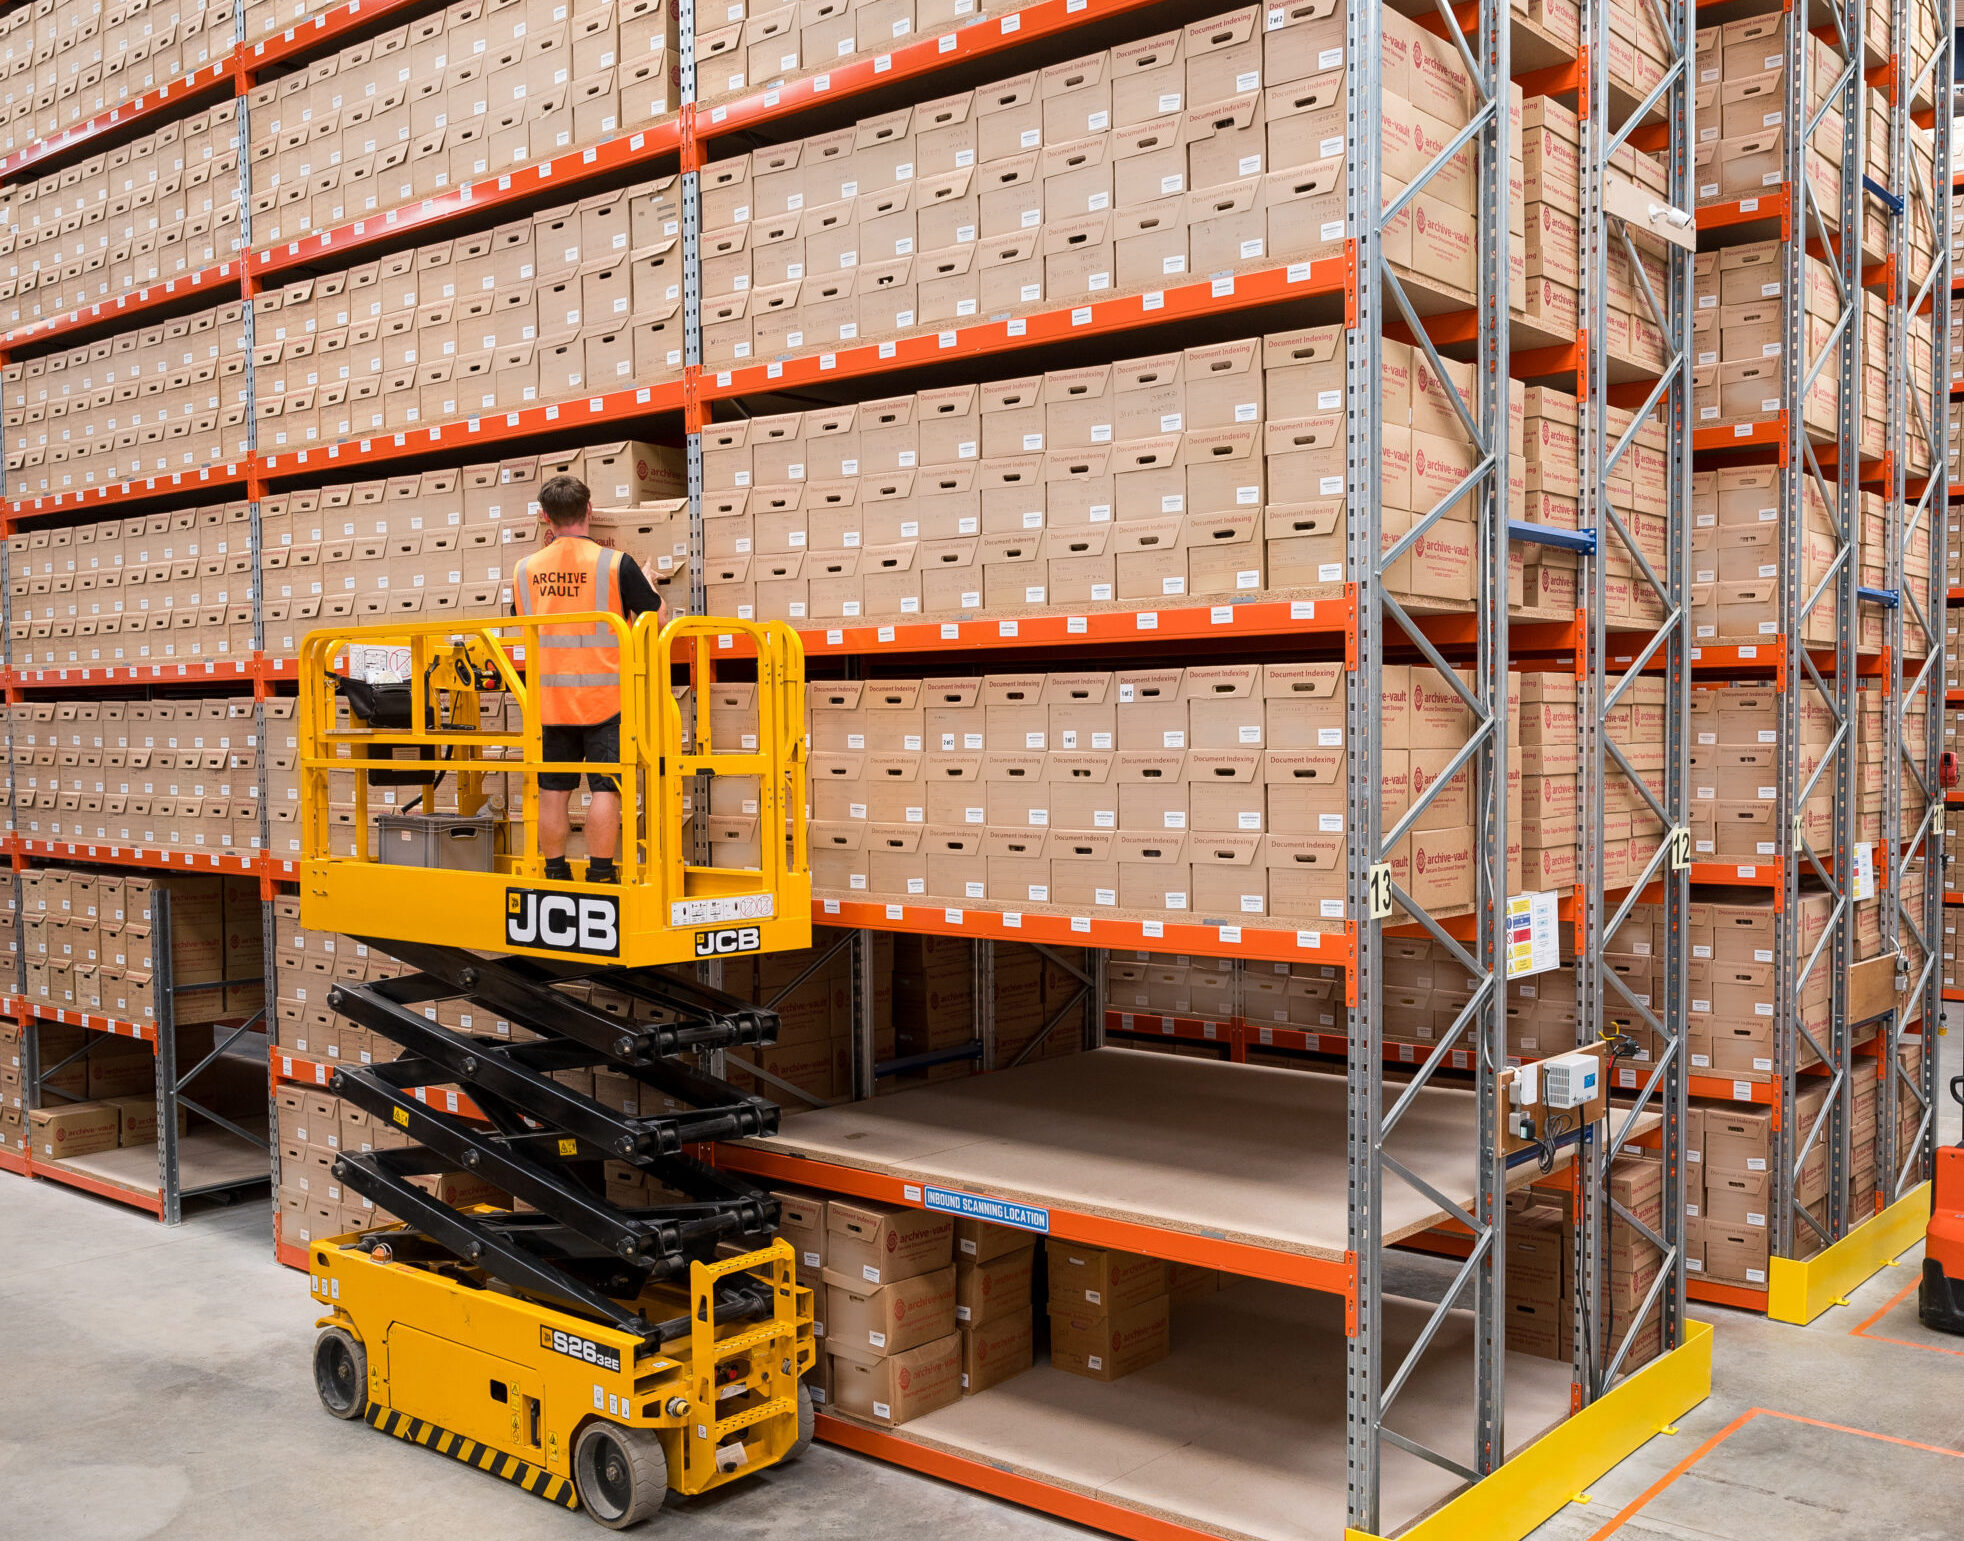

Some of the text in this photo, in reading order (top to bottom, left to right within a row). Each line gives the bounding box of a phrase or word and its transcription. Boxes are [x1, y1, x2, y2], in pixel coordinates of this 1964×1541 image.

[1190, 14, 1250, 35] Document Indexing
[1117, 39, 1174, 58] Document Indexing
[1044, 58, 1099, 77] Document Indexing
[1424, 56, 1466, 86] archive-vault
[979, 78, 1030, 95] Document Indexing
[1272, 78, 1337, 97] Document Indexing
[1189, 101, 1250, 121] Document Indexing
[1117, 120, 1175, 138] Document Indexing
[1427, 220, 1469, 245] archive-vault
[1269, 334, 1332, 347] Document Indexing
[1189, 346, 1250, 360] Document Indexing
[1117, 359, 1175, 373] Document Indexing
[1048, 373, 1078, 382] Document
[984, 385, 1012, 393] Document
[1269, 419, 1334, 431] Document Indexing
[1189, 432, 1250, 444] Document Indexing
[1427, 460, 1469, 477] archive-vault
[1269, 506, 1334, 519] Document Indexing
[1191, 518, 1223, 526] Document
[1427, 540, 1469, 557] archive-vault
[532, 572, 587, 586] ARCHIVE
[540, 586, 580, 597] VAULT
[1425, 692, 1464, 704] archive-vau
[1935, 808, 1943, 830] 10
[1427, 849, 1468, 864] archive-vault
[1674, 832, 1690, 864] 12
[1371, 869, 1391, 912] 13
[508, 894, 617, 951] JCB
[697, 928, 760, 955] JCB
[928, 1191, 960, 1209] INBOUND
[963, 1198, 1003, 1218] SCANNING
[1004, 1207, 1045, 1227] LOCATION
[901, 1223, 951, 1243] archive-vault
